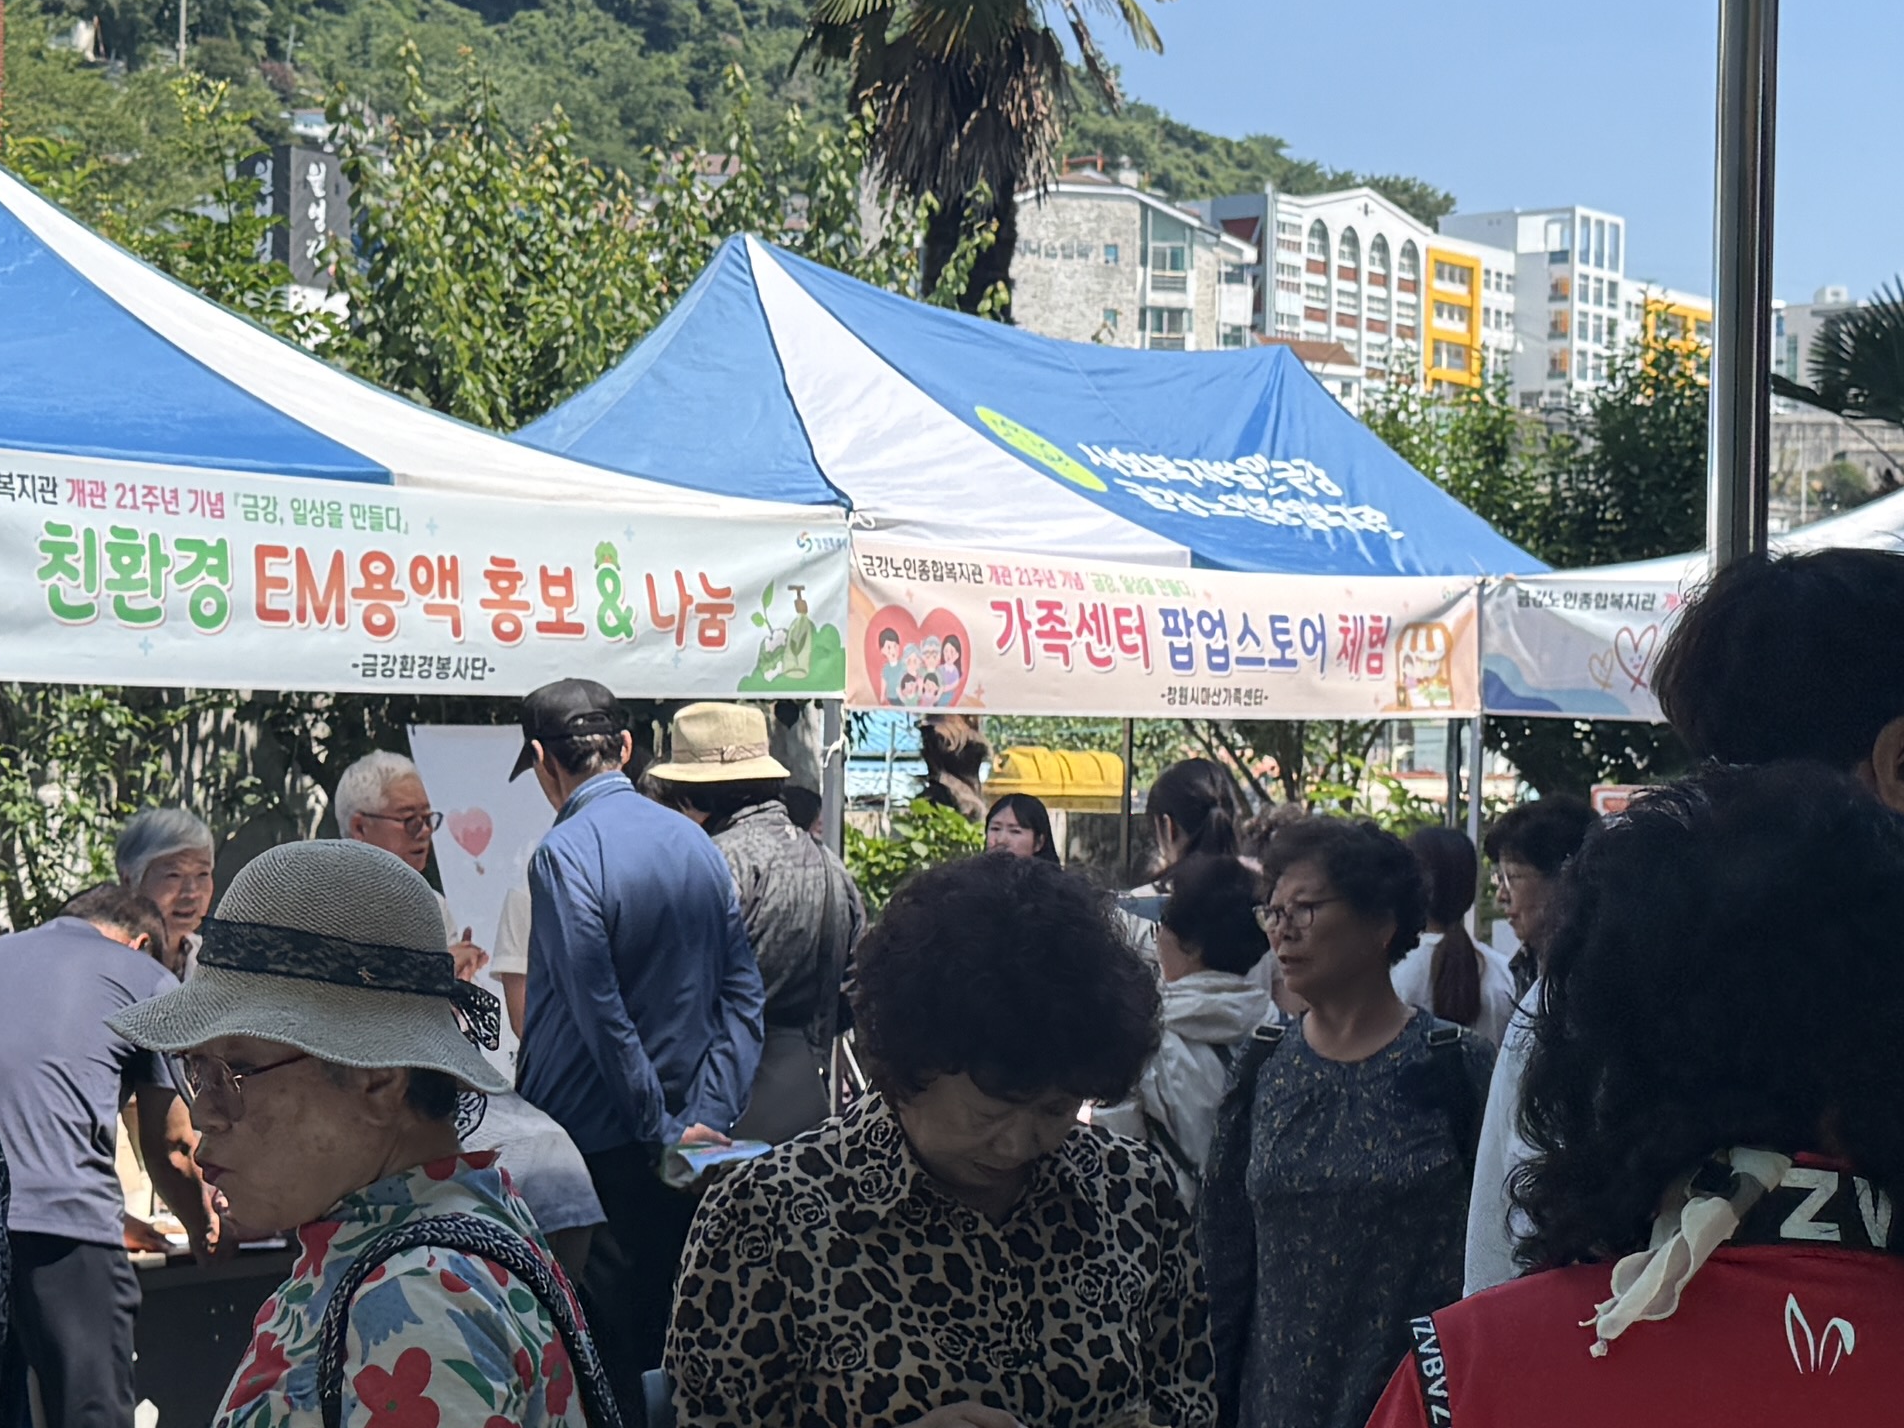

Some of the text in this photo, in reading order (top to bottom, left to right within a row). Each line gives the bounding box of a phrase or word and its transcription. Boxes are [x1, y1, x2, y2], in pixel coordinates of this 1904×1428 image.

[67, 478, 107, 509] 개관
[115, 482, 180, 516] 21주년
[188, 487, 225, 519] 기념
[290, 497, 344, 529] 일상을
[37, 520, 230, 631] 친환경
[255, 544, 463, 640] EM용액
[862, 554, 984, 584] 금강노인종합복지관
[986, 564, 1013, 586] 개관
[1016, 567, 1057, 589] 21주년
[990, 597, 1392, 676] 가족센터 팝업스토어 체험
[351, 653, 496, 681] -금강환경봉사단-
